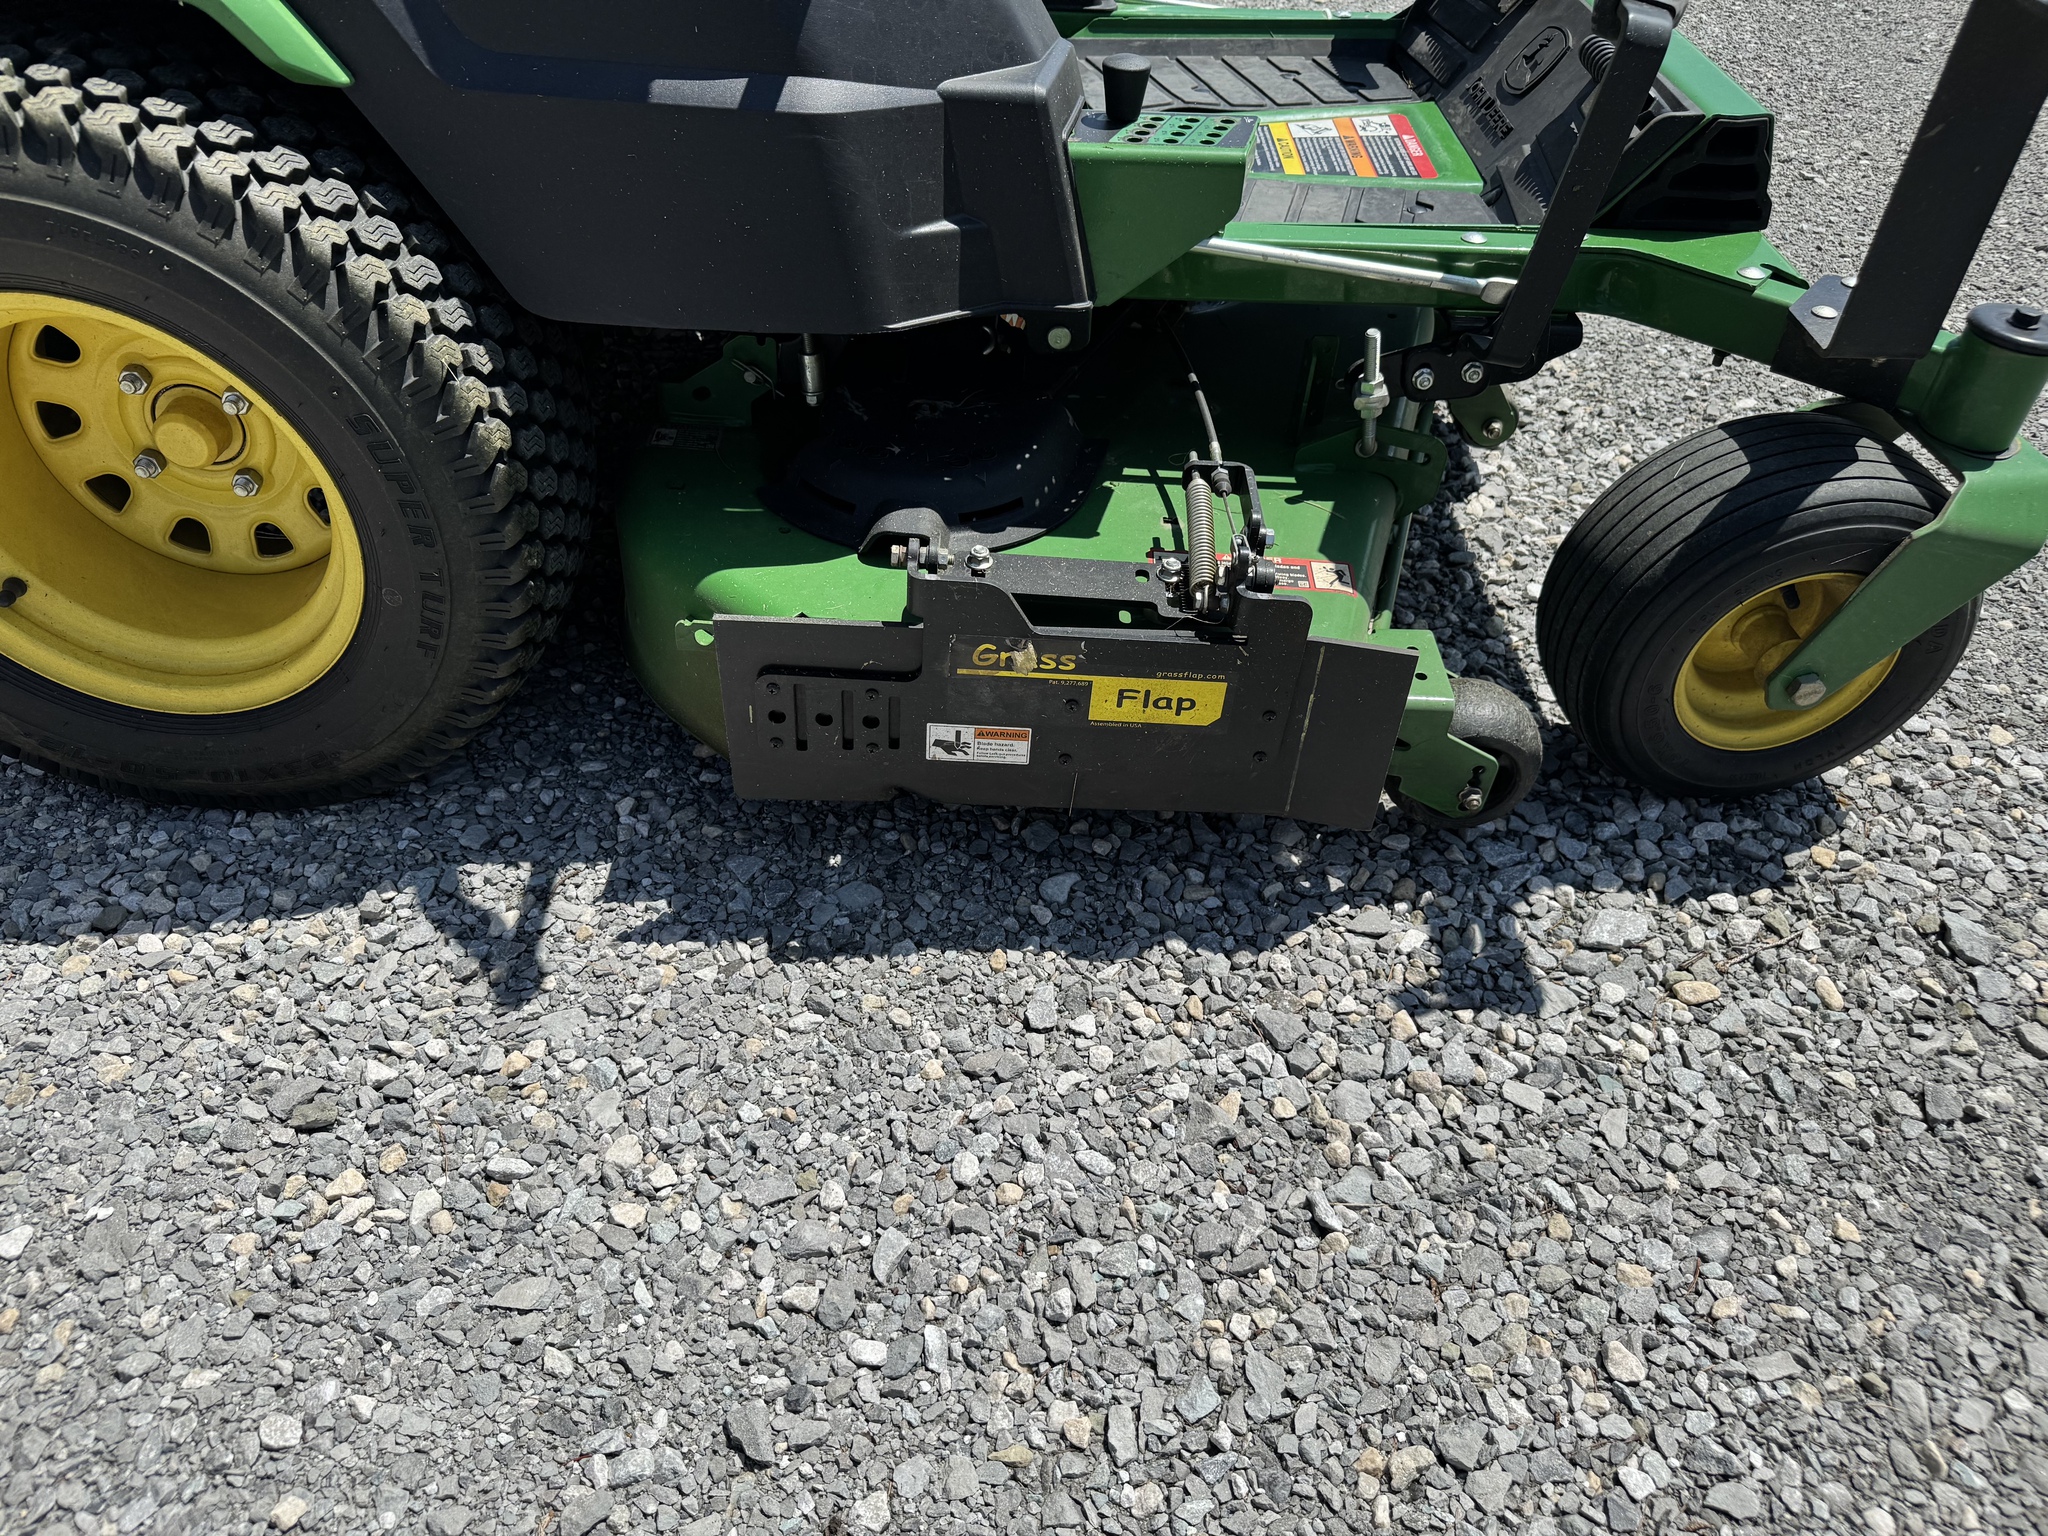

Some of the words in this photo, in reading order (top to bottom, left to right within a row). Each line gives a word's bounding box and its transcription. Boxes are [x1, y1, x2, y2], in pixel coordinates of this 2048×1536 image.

[1465, 76, 1491, 108] JOHN
[1479, 97, 1515, 140] DEERE
[345, 413, 437, 549] SUPER
[416, 567, 446, 660] TURF
[972, 643, 1077, 671] Grss
[1156, 670, 1227, 681] grassflap.com
[1116, 688, 1197, 716] Flap
[985, 730, 1028, 739] WARNING
